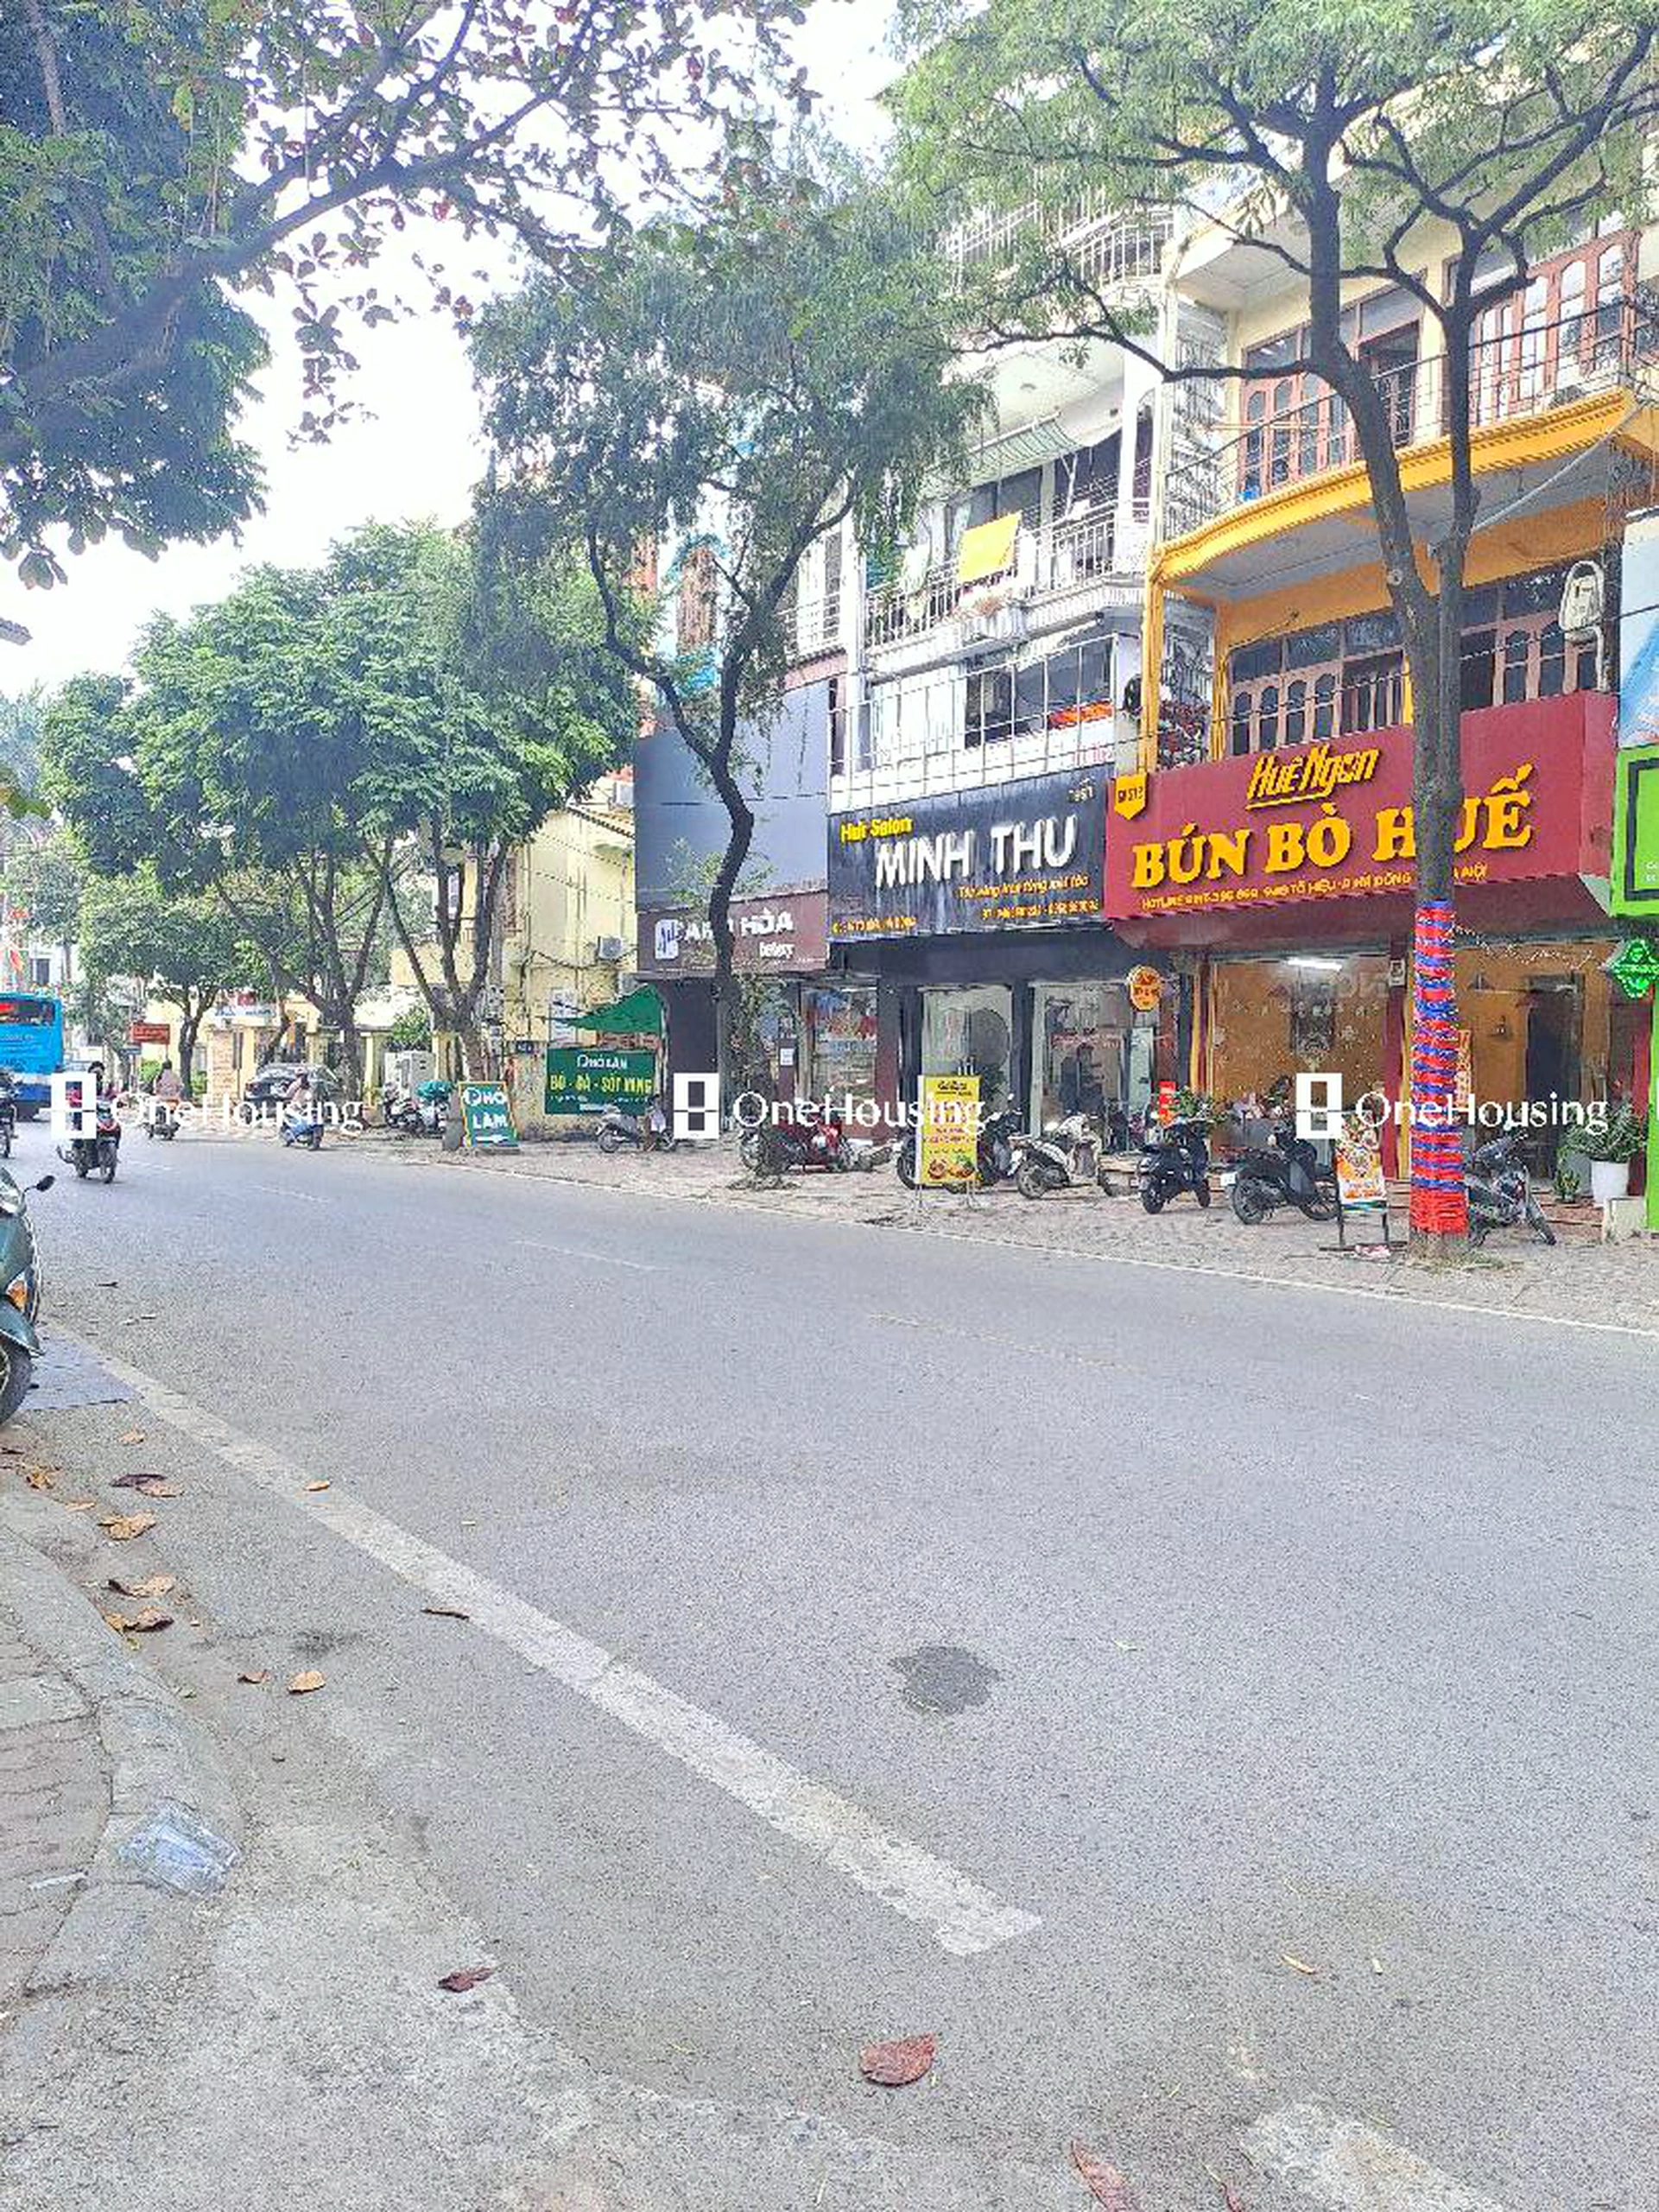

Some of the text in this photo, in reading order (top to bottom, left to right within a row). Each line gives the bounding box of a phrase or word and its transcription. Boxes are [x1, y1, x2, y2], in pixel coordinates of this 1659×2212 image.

[875, 814, 1078, 887] MINH THU
[1130, 822, 1250, 889] BÚN
[1264, 804, 1351, 873] BÒ
[741, 908, 794, 937] HÒA
